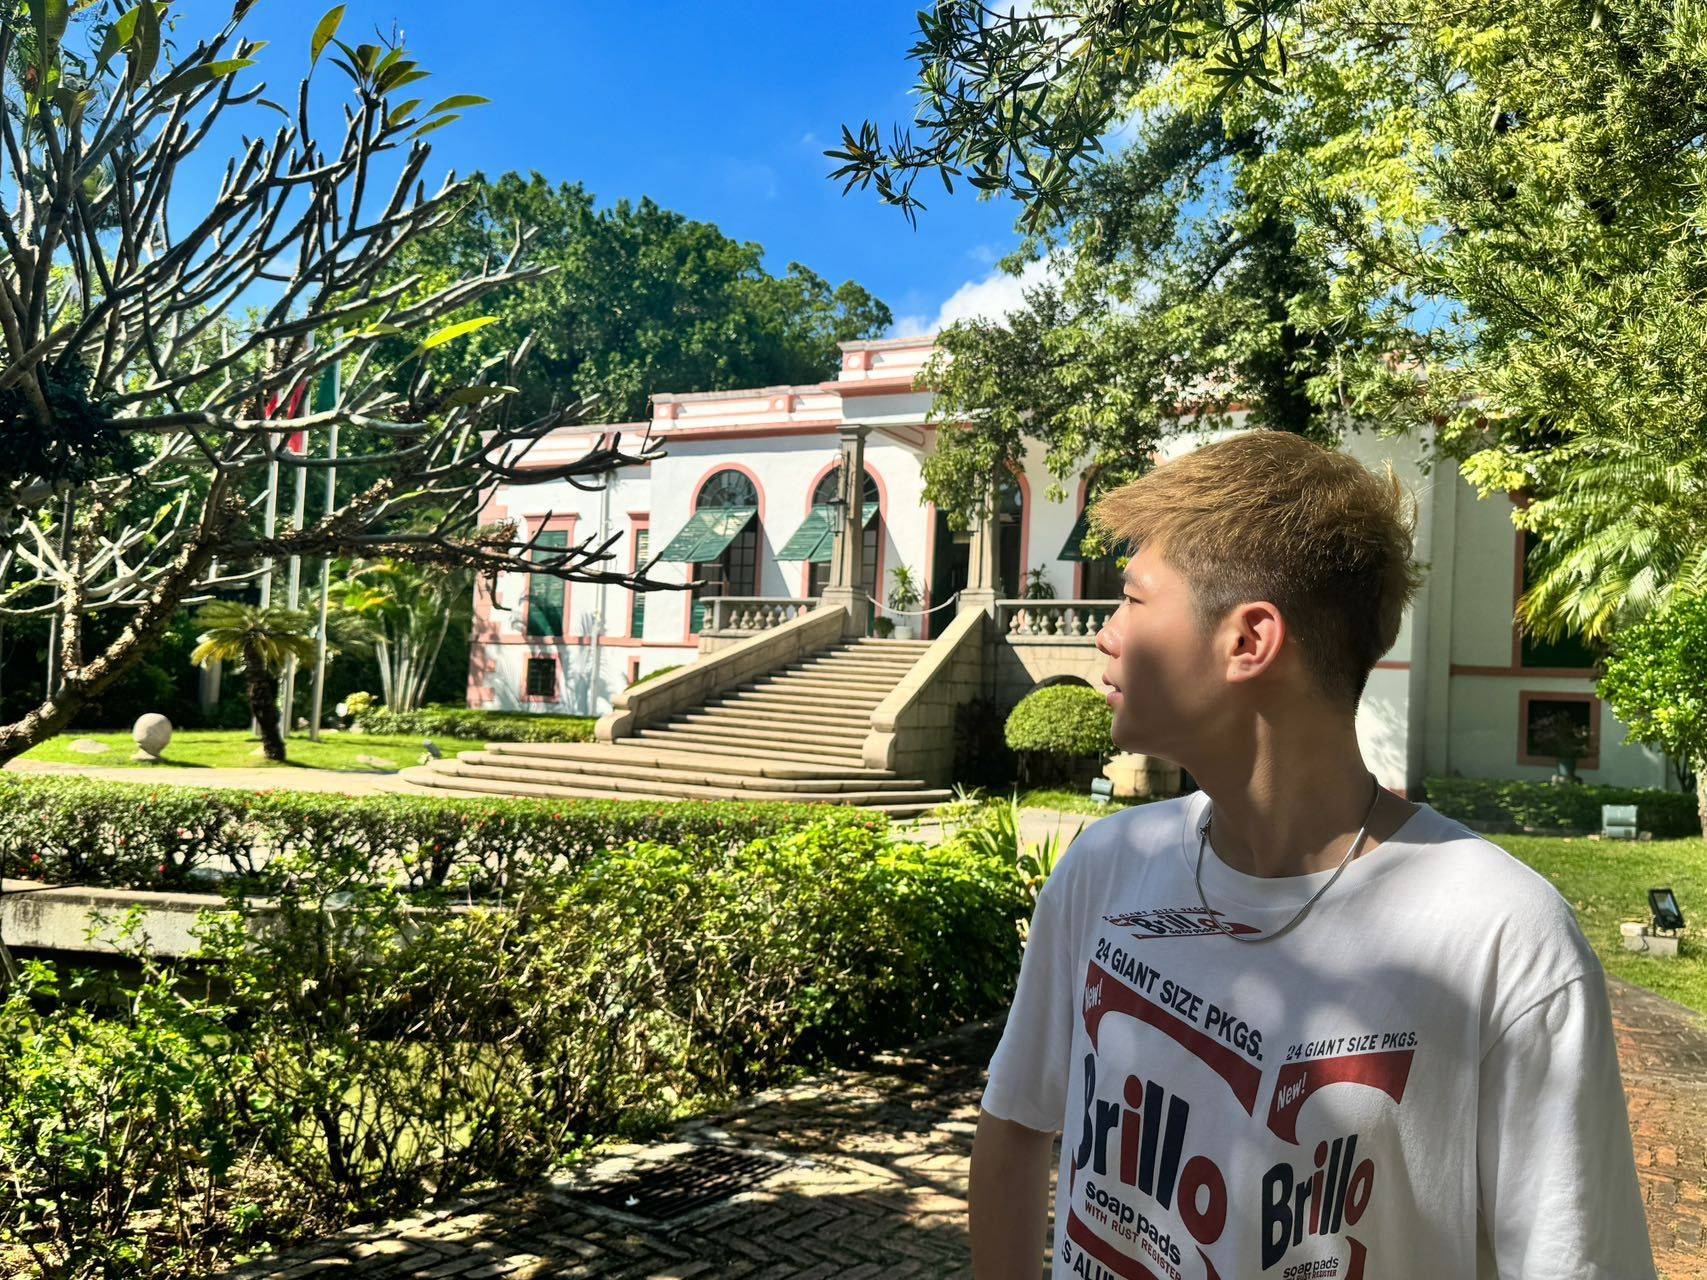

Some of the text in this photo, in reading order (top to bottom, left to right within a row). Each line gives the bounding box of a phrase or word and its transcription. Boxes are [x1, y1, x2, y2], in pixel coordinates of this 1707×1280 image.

[1130, 913, 1219, 934] Brillo
[1095, 938, 1264, 1061] 24 GIANT SIZE PKGS.
[1286, 1031, 1418, 1060] 24 GIANT SIZE PKGS.
[1276, 1071, 1307, 1112] New!
[1076, 1053, 1228, 1245] Brillo
[1085, 1200, 1107, 1224] WITH
[1111, 1219, 1139, 1243] RUST
[1085, 1181, 1181, 1266] soap pads
[1262, 1134, 1374, 1271] Brillo
[1283, 1256, 1339, 1278] soap pads
